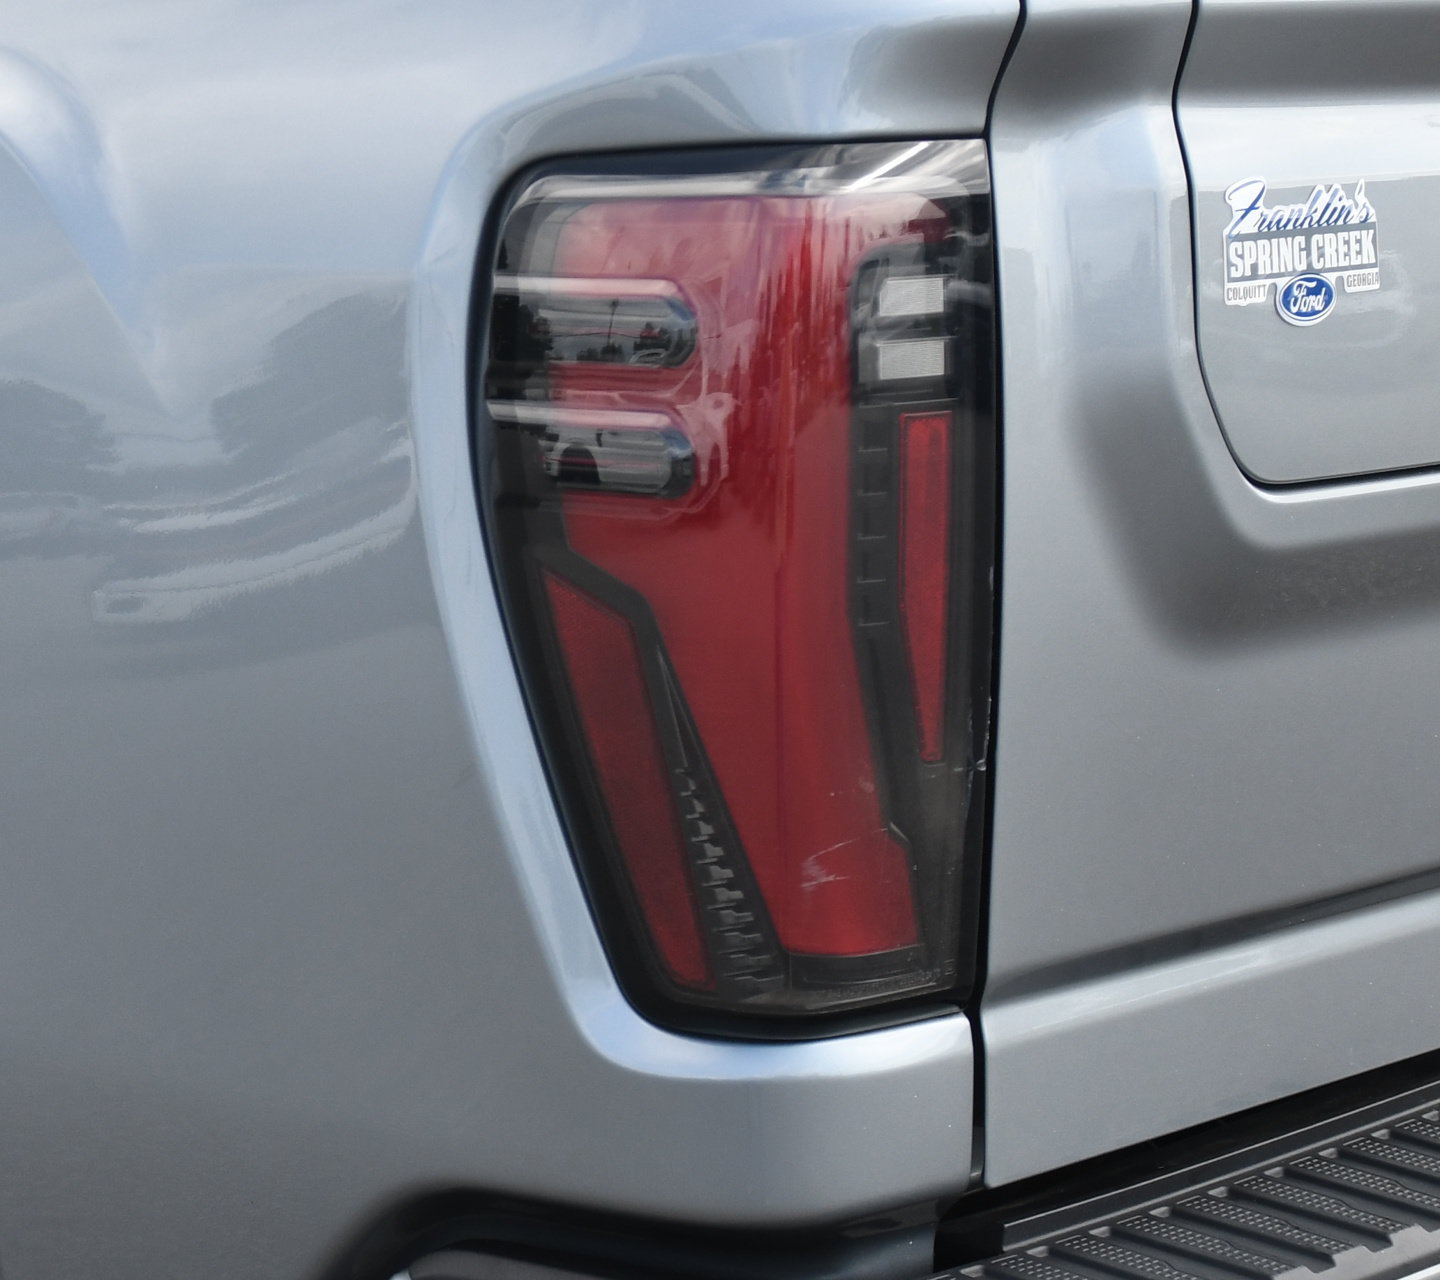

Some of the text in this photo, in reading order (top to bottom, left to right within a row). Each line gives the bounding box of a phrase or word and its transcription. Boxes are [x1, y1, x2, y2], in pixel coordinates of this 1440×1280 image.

[1227, 179, 1375, 240] Franklin's
[1228, 228, 1377, 279] SPRING CREEK
[1226, 283, 1268, 302] COLQUITT
[1346, 271, 1380, 288] GEORGIA
[1289, 280, 1327, 314] Ford
